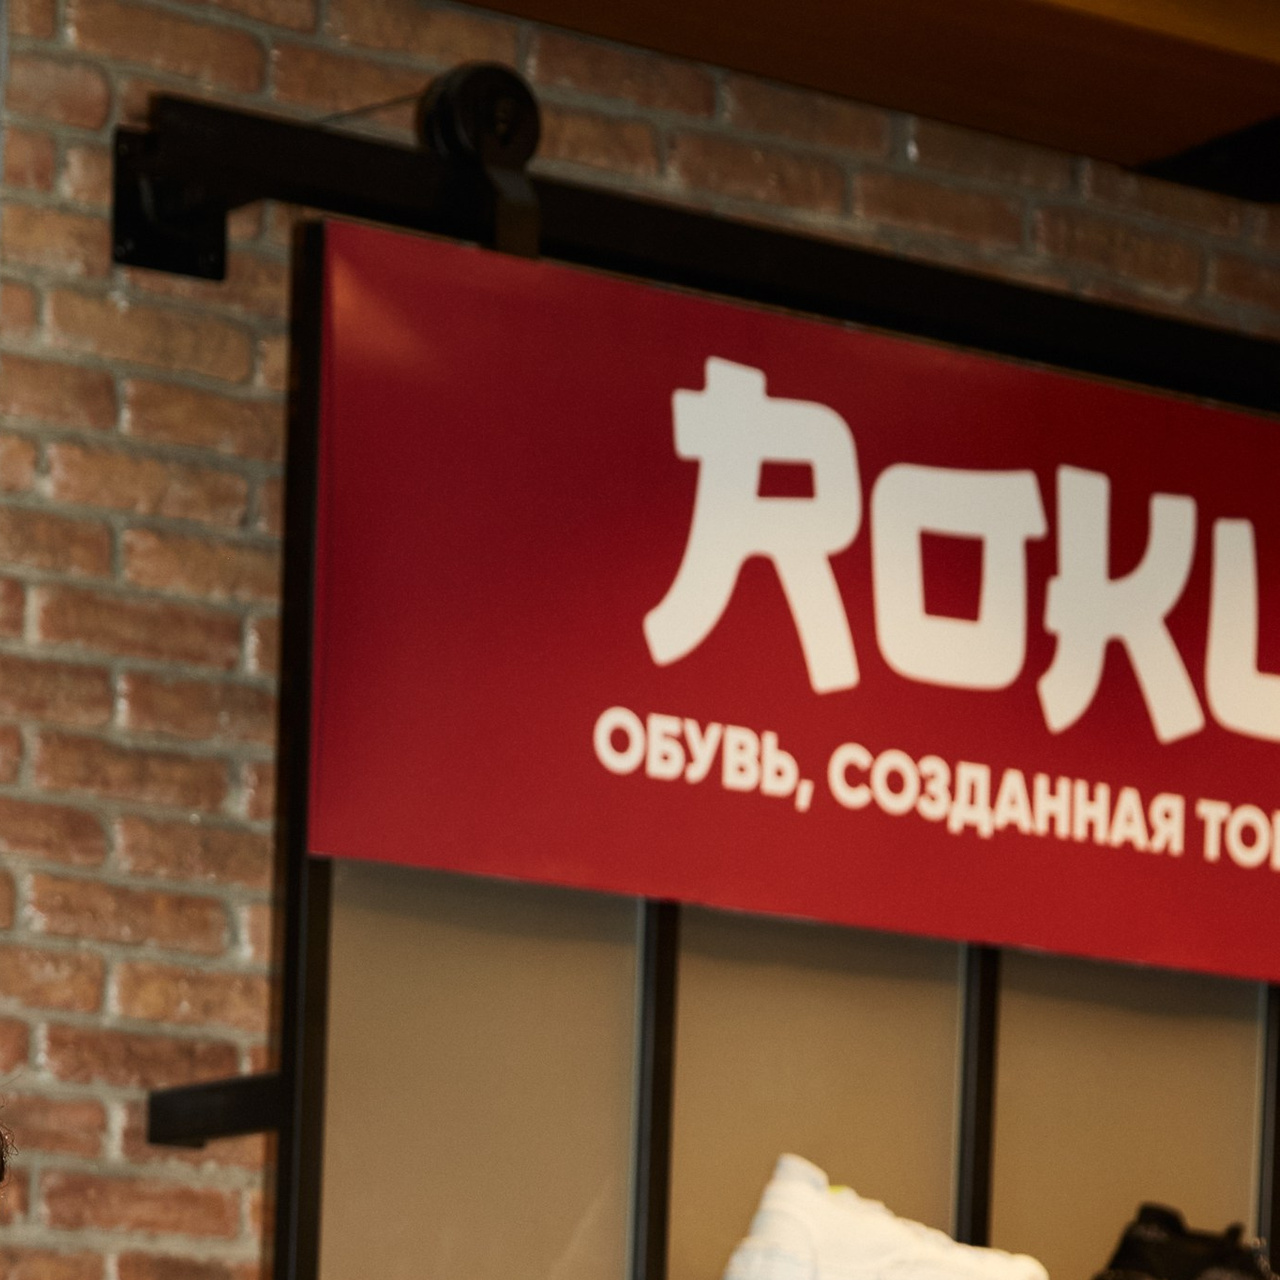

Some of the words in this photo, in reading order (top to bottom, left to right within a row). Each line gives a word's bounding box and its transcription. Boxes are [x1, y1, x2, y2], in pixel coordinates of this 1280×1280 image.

[593, 706, 814, 812] ОБУВЬ,
[827, 743, 1186, 857] СОЗДАННАЯ
[1195, 798, 1280, 872] ТО
